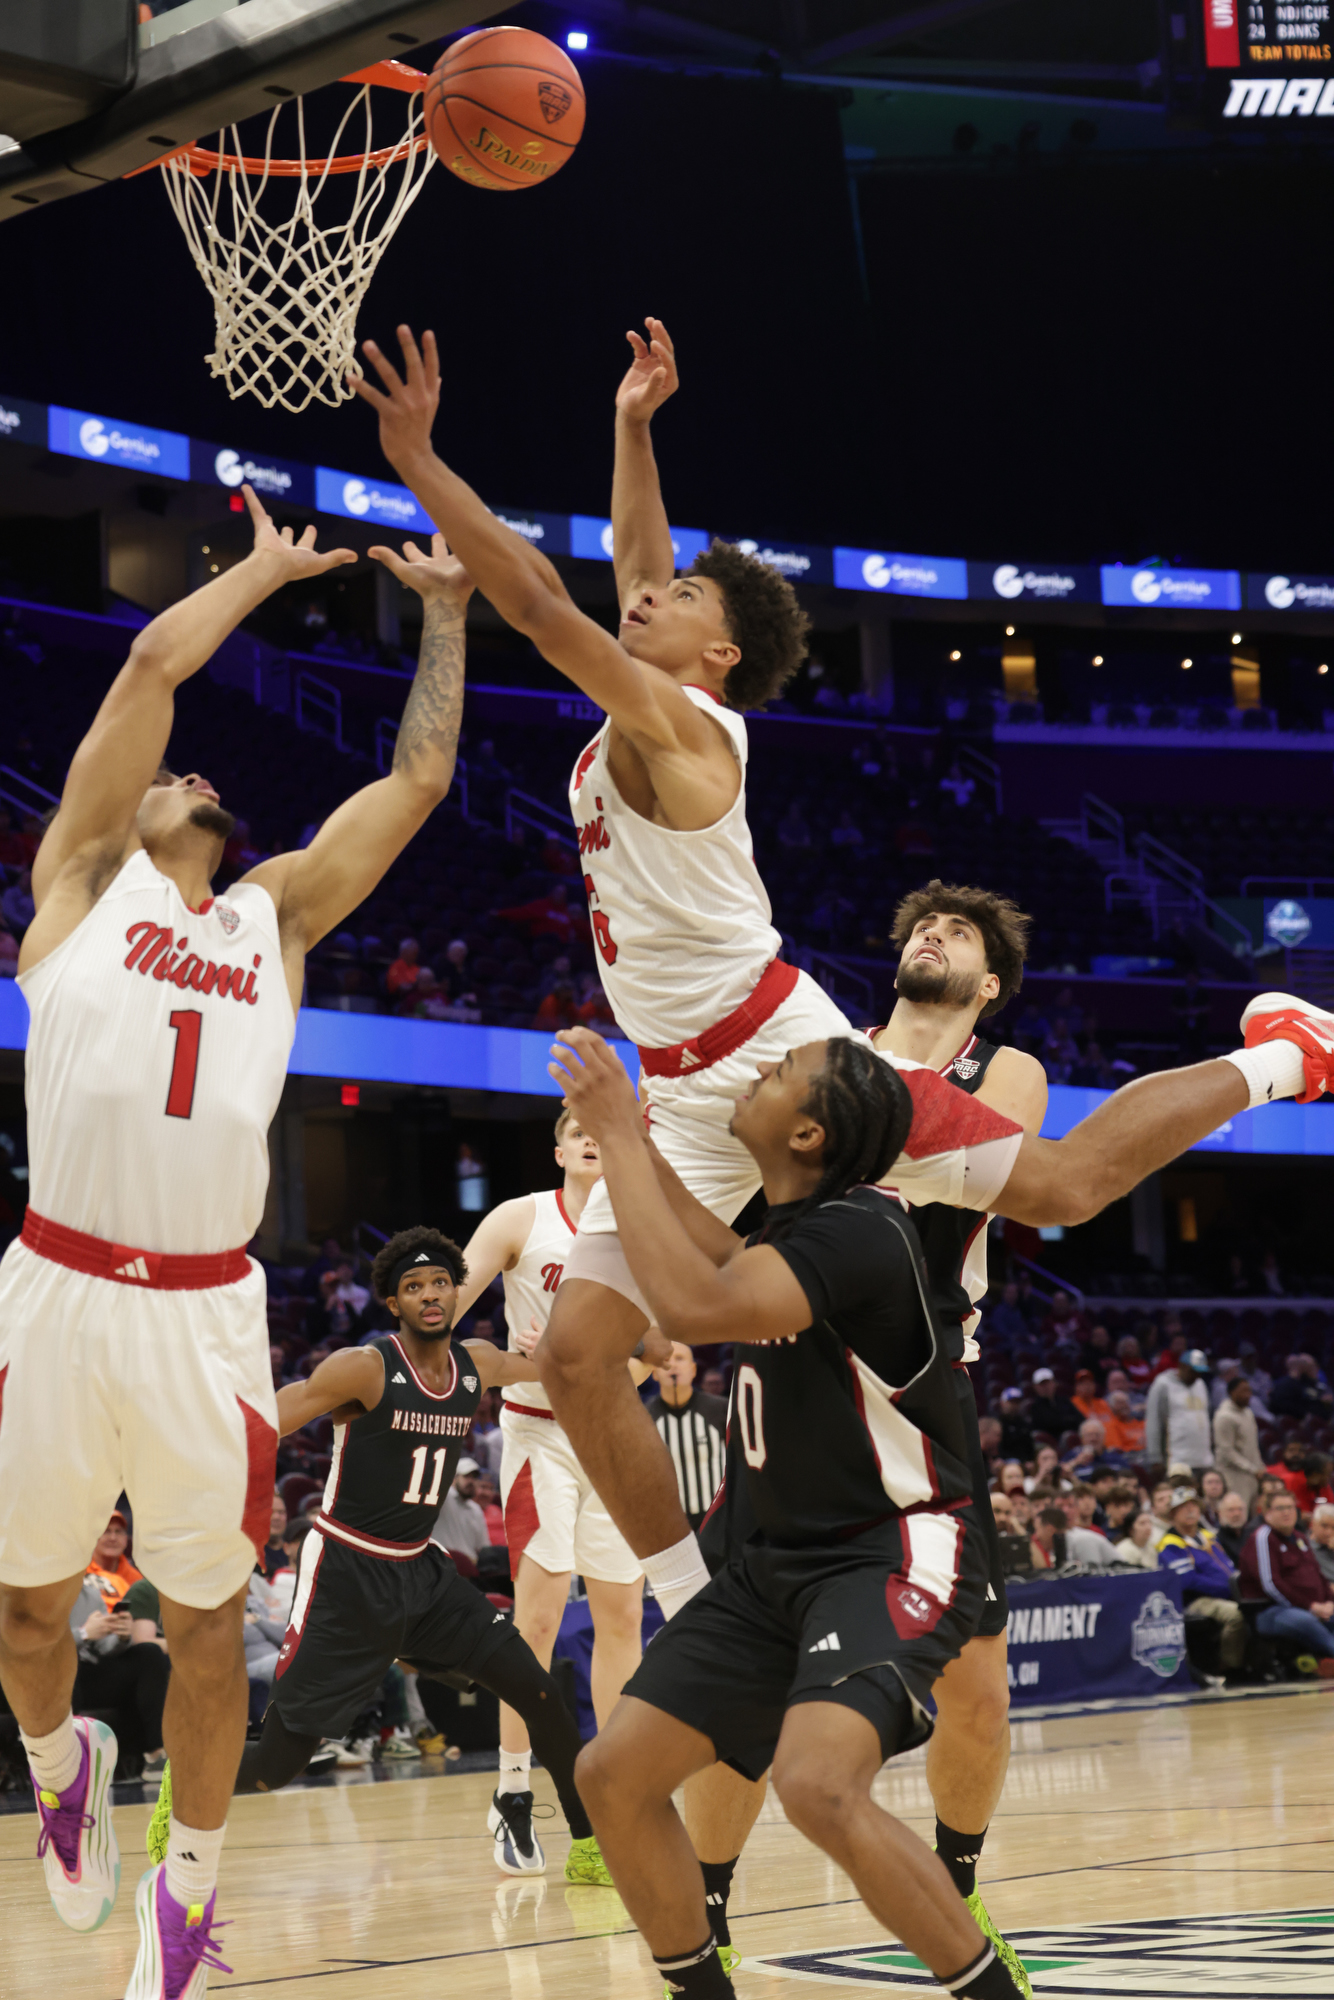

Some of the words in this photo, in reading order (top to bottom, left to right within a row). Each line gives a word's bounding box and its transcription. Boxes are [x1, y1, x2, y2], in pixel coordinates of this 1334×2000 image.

[1248, 5, 1264, 20] 11
[1248, 23, 1266, 40] 24
[1276, 23, 1320, 39] BANKS
[1249, 45, 1283, 60] TEAM
[1284, 44, 1332, 60] TOTALS
[469, 126, 563, 177] SPALDIN
[109, 431, 160, 458] Genius
[243, 461, 292, 488] Genius
[369, 490, 417, 516] Genius
[890, 563, 938, 584] Genius
[1023, 571, 1076, 591] Genius
[1159, 576, 1212, 596] Genius
[124, 921, 262, 1005] Miami
[164, 1009, 203, 1120] 1
[737, 1362, 768, 1472] 0
[401, 1444, 448, 1507] 11
